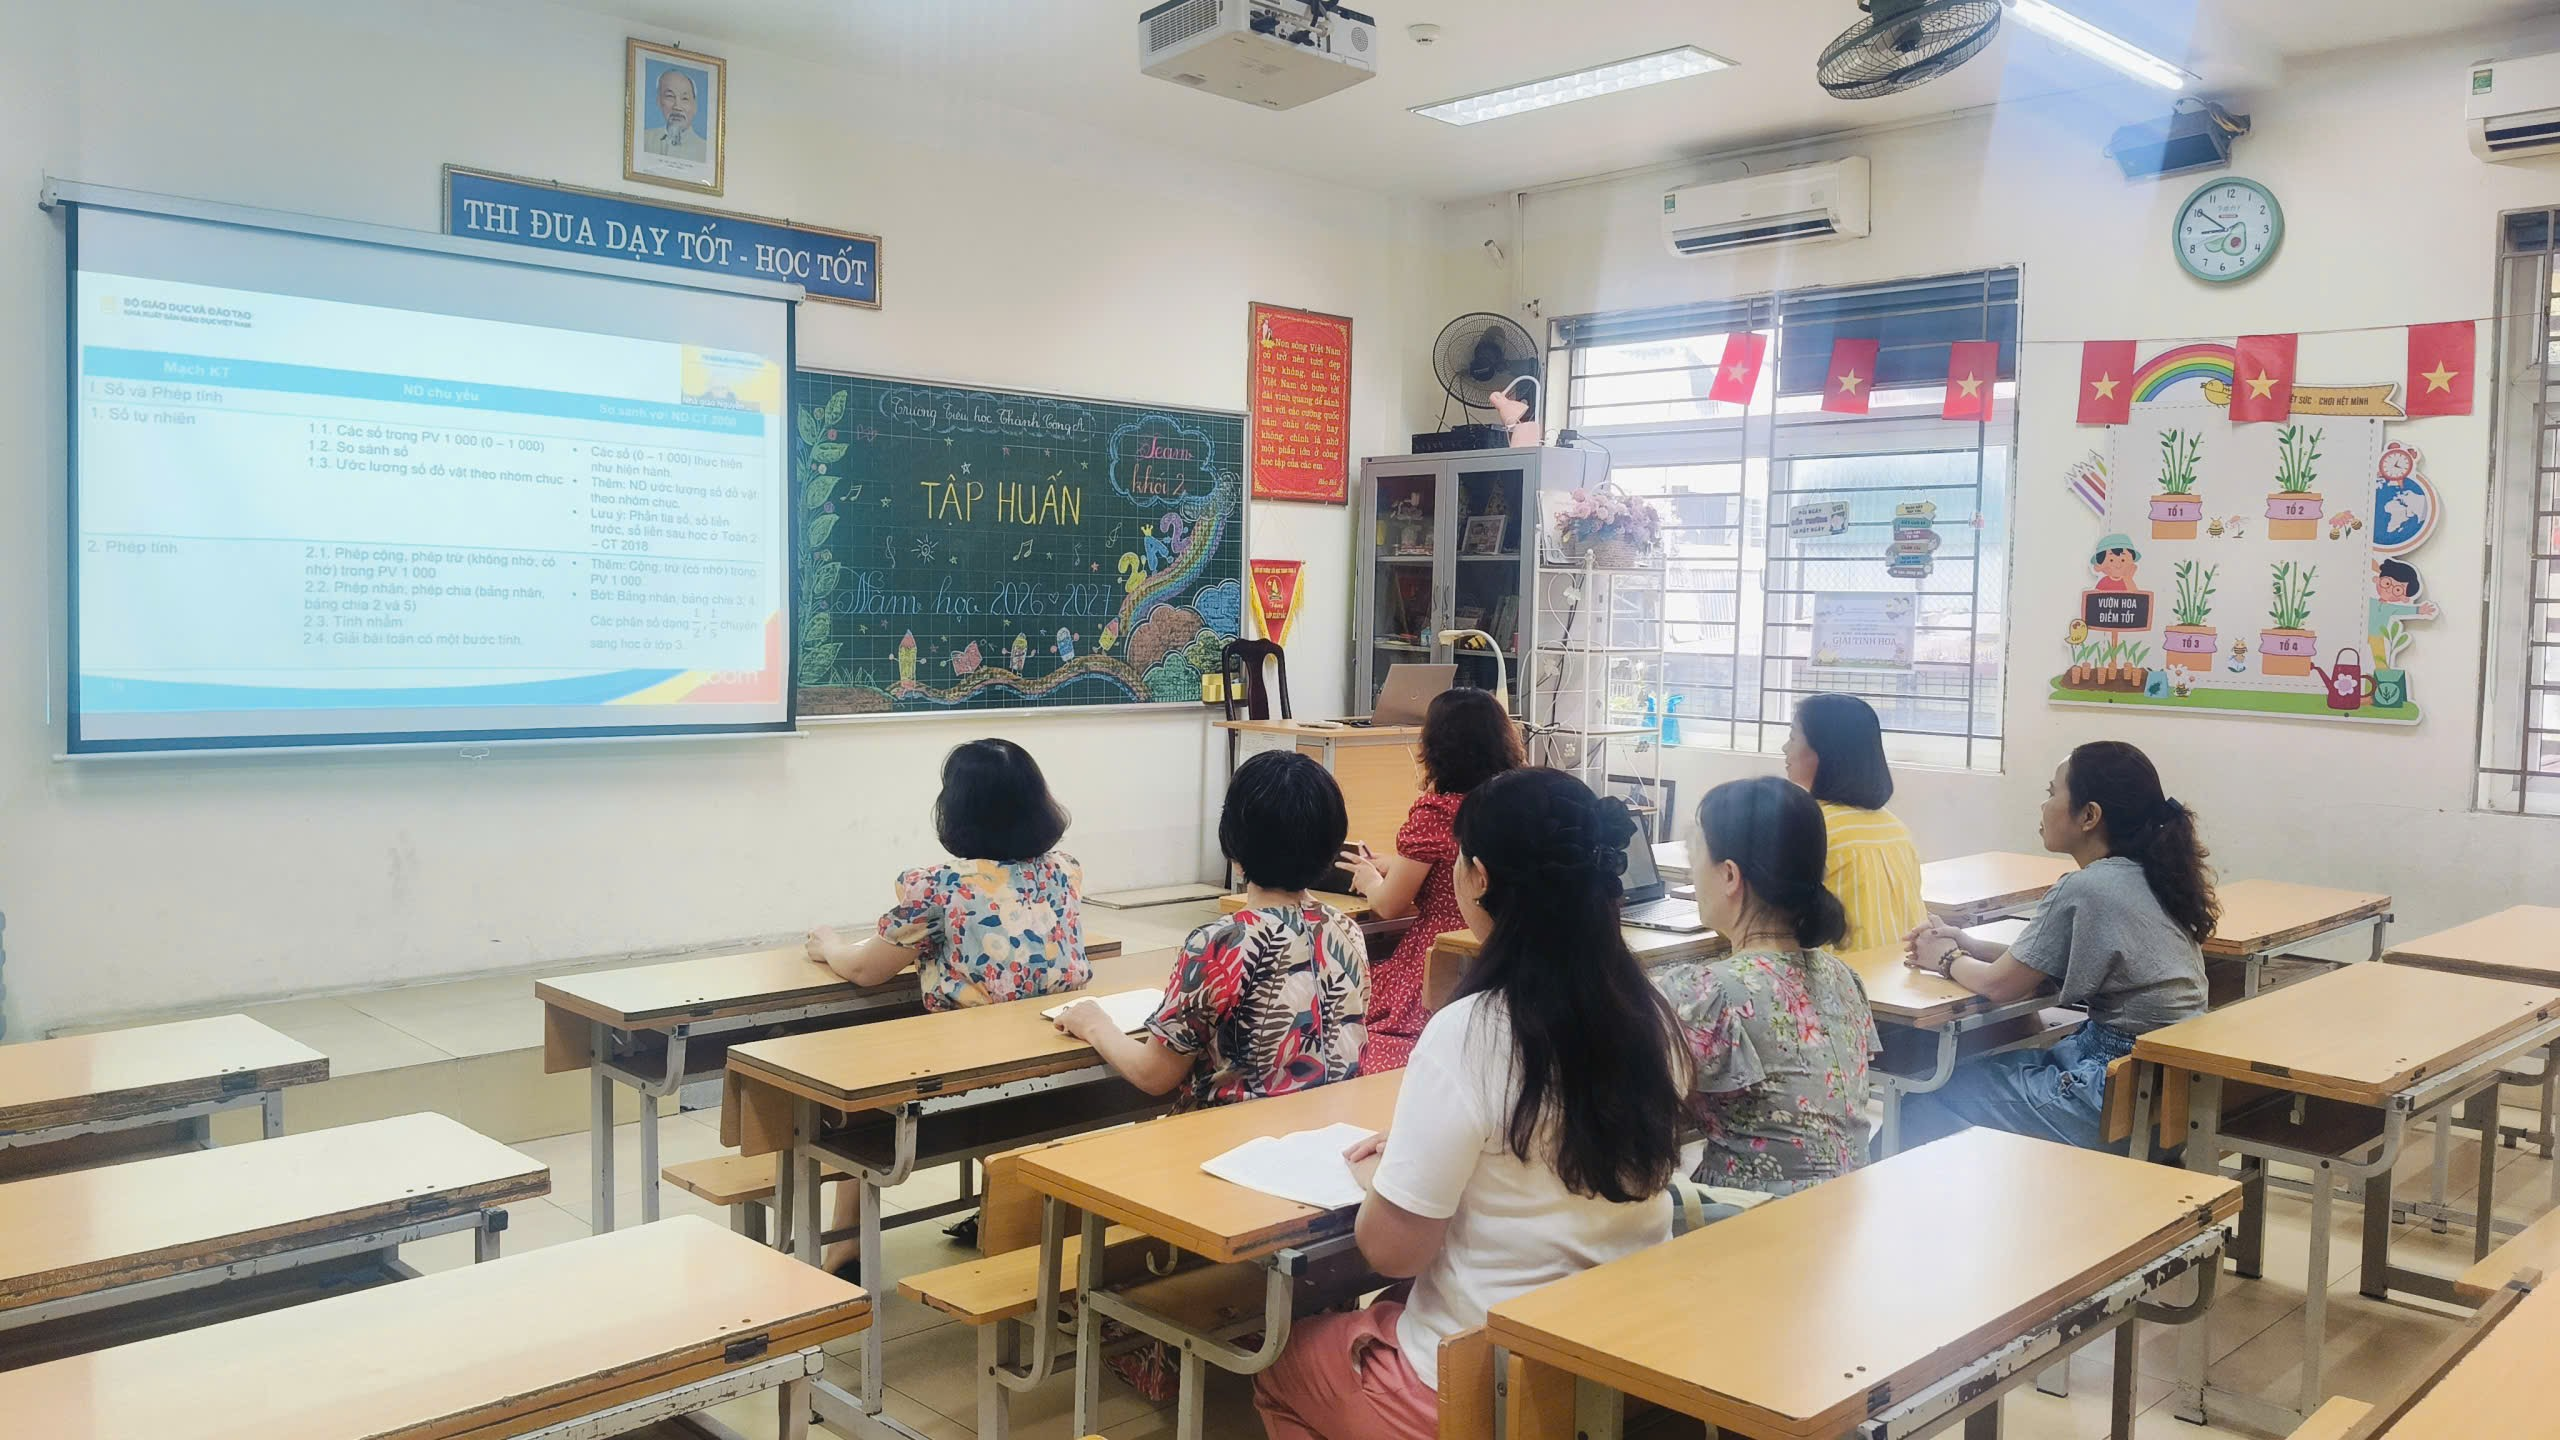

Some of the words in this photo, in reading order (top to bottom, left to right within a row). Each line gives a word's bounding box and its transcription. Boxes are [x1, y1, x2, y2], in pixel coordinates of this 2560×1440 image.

[2210, 194, 2216, 204] 11
[2227, 189, 2236, 198] 12
[2248, 193, 2252, 202] 1
[2194, 208, 2202, 217] 10
[2260, 205, 2266, 214] 2
[2264, 224, 2270, 234] 3
[463, 198, 518, 234] THI
[530, 209, 596, 247] ĐUA
[606, 220, 670, 261] DẠY
[678, 222, 733, 266] TỐT
[755, 244, 810, 284] HỌC
[817, 245, 867, 286] TỐT
[2190, 244, 2196, 254] 8
[2254, 244, 2260, 252] 4
[2202, 258, 2208, 266] 7
[2220, 263, 2226, 272] 6
[2240, 258, 2245, 266] 5
[163, 361, 203, 379] Mạch
[208, 366, 232, 378] KT
[104, 381, 124, 396] Số
[130, 385, 146, 398] và
[152, 385, 192, 402] Phép
[196, 390, 224, 403] tính
[2298, 394, 2313, 405] SỨC
[2319, 396, 2335, 406] CHƠI
[2336, 394, 2350, 406] HẾT
[2350, 394, 2369, 406] MÌNH
[110, 406, 129, 420] Số
[134, 410, 148, 424] tự
[154, 410, 196, 425] nhiên
[336, 440, 354, 454] So
[358, 442, 390, 456] sánh
[393, 444, 408, 458] số
[422, 431, 440, 443] PV
[455, 434, 478, 446] 000
[481, 436, 494, 449] (0
[518, 439, 544, 454] 000)
[1136, 432, 1196, 460] Team
[470, 467, 496, 480] theo
[1132, 463, 1167, 495] khối
[1172, 472, 1187, 496] 2
[920, 473, 984, 527] TẬP
[998, 469, 1082, 527] HUẤN
[2168, 504, 2180, 517] TỔ
[2180, 507, 2184, 517] 1
[2286, 502, 2296, 516] TỔ
[2298, 506, 2305, 516] 2
[621, 540, 648, 552] 2018
[306, 564, 336, 578] nhớ)
[341, 564, 374, 580] trong
[378, 566, 398, 578] PV
[402, 567, 408, 577] 1
[413, 566, 436, 578] 000
[833, 566, 922, 616] Năm
[932, 575, 980, 618] học
[989, 582, 1045, 617] 2026
[1060, 582, 1112, 617] 2027
[2098, 596, 2120, 610] VƯỜN
[2121, 598, 2138, 610] HOA
[2099, 609, 2120, 624] ĐIỂM
[2122, 610, 2135, 624] TỐT
[2182, 634, 2192, 650] TỔ
[2192, 638, 2200, 649] 3
[2280, 638, 2290, 652] TỔ
[2290, 641, 2298, 652] 4
